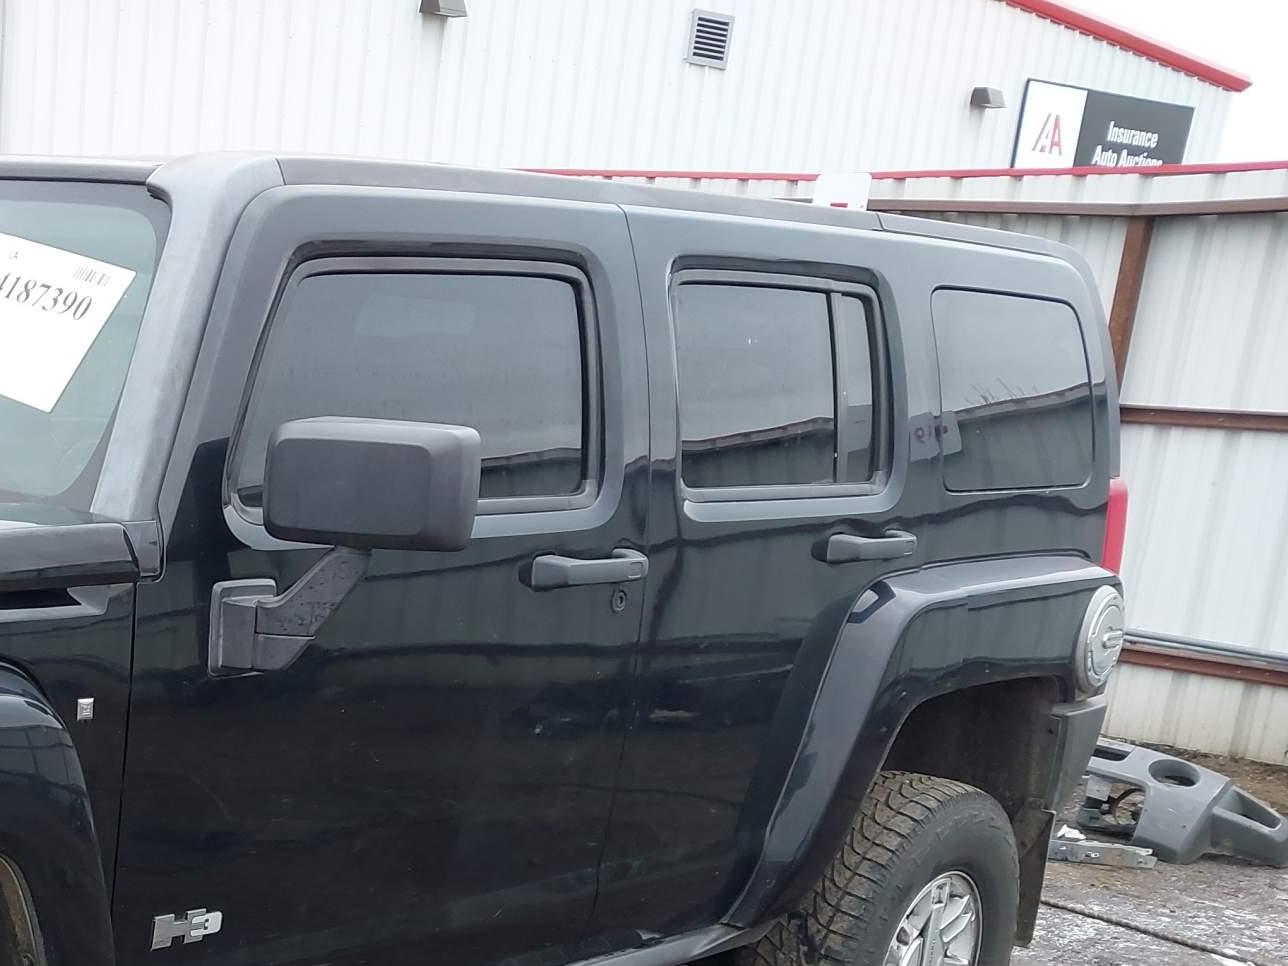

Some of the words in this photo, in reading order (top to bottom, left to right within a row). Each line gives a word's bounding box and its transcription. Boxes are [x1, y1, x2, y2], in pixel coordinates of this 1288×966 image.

[1107, 120, 1159, 149] Insurance
[1091, 144, 1118, 168] Auto
[150, 907, 223, 951] H3
